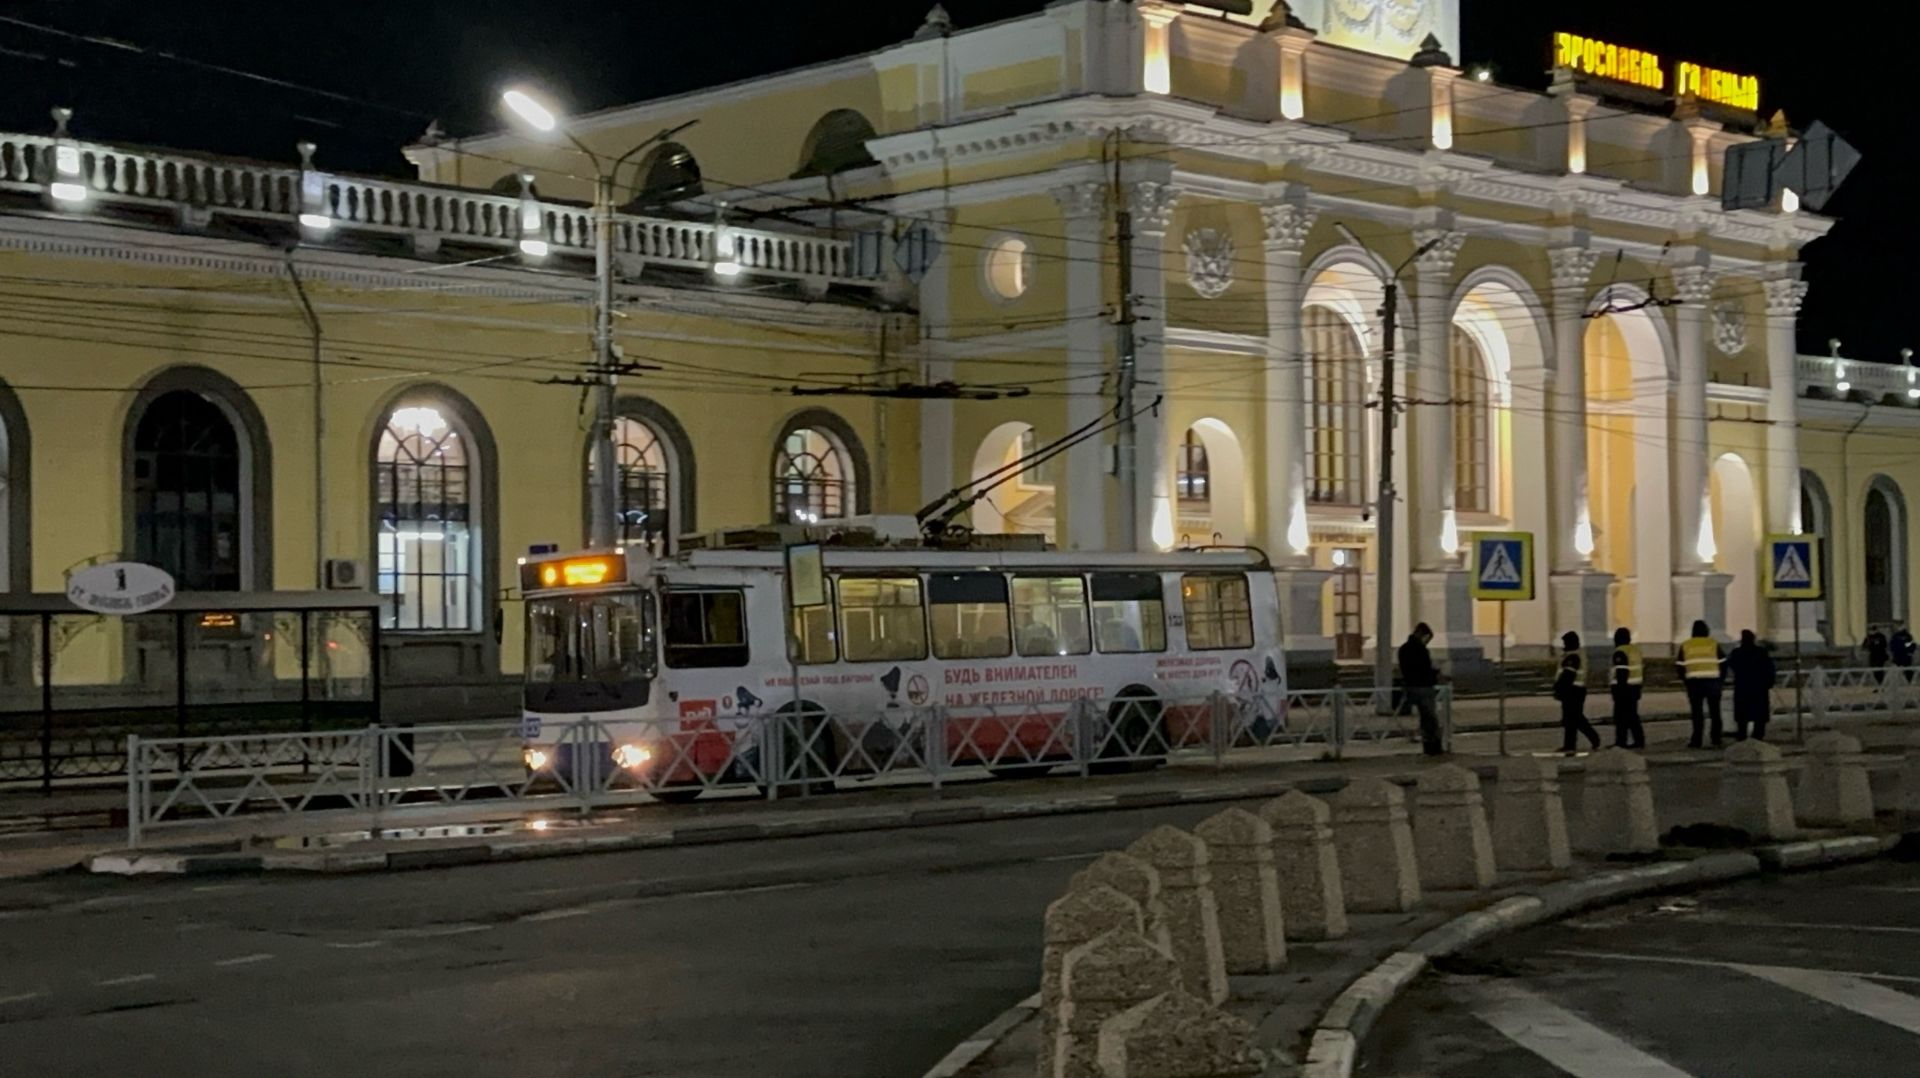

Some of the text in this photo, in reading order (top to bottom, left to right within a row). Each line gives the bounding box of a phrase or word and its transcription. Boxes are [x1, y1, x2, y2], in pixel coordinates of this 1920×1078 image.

[1555, 32, 1664, 90] ЯРОСЛАВЛЬ
[944, 665, 1077, 686] БУДЬ ВНИМАТЕЛЕН
[945, 692, 966, 708] НА
[968, 687, 1044, 706] ЖЕЛЕЗНОЙ
